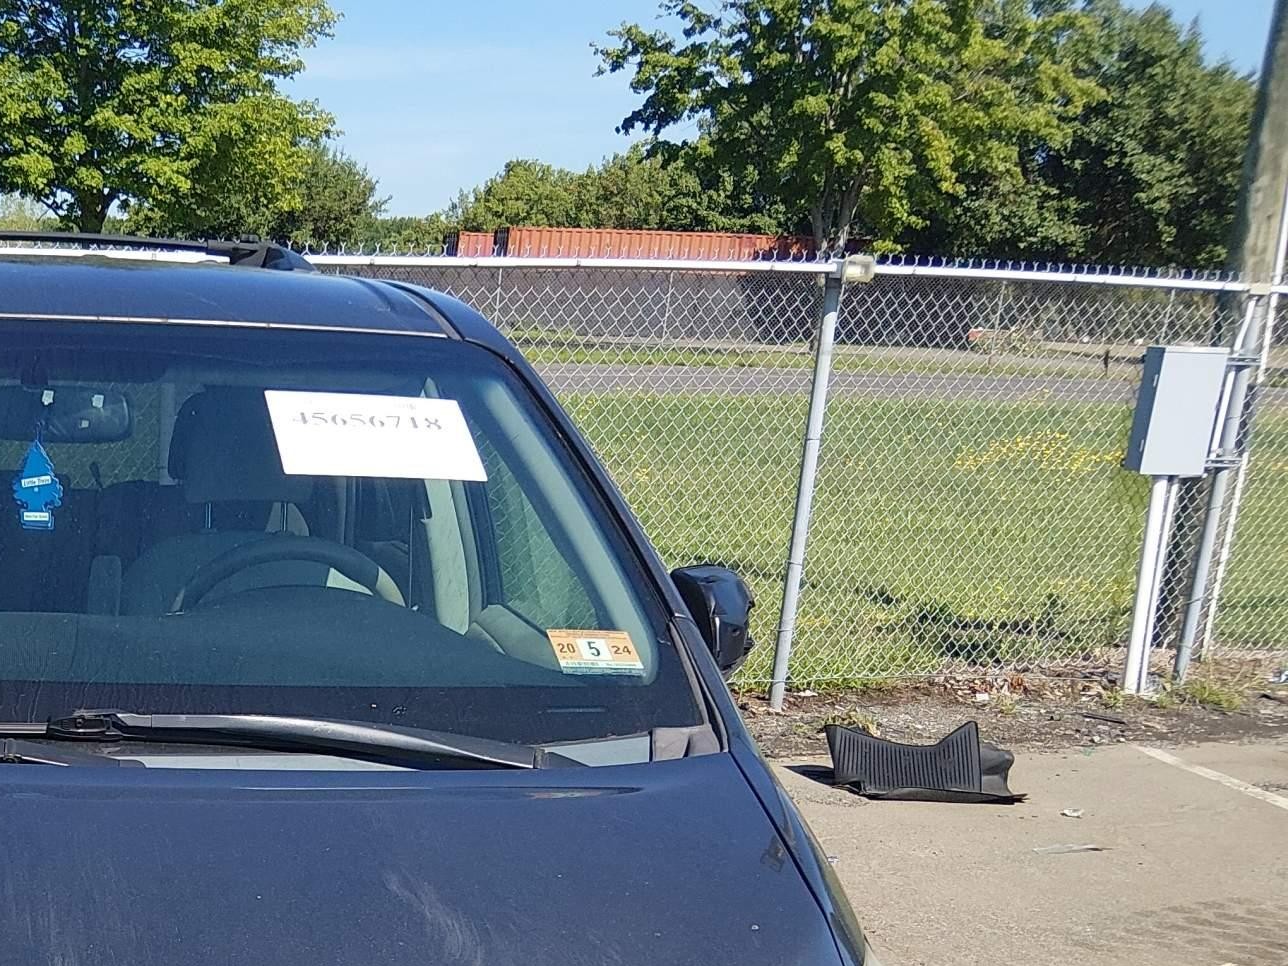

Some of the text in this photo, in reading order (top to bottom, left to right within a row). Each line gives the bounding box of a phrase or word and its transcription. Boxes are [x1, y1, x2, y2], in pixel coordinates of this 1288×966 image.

[557, 641, 632, 657] 20 5 24
